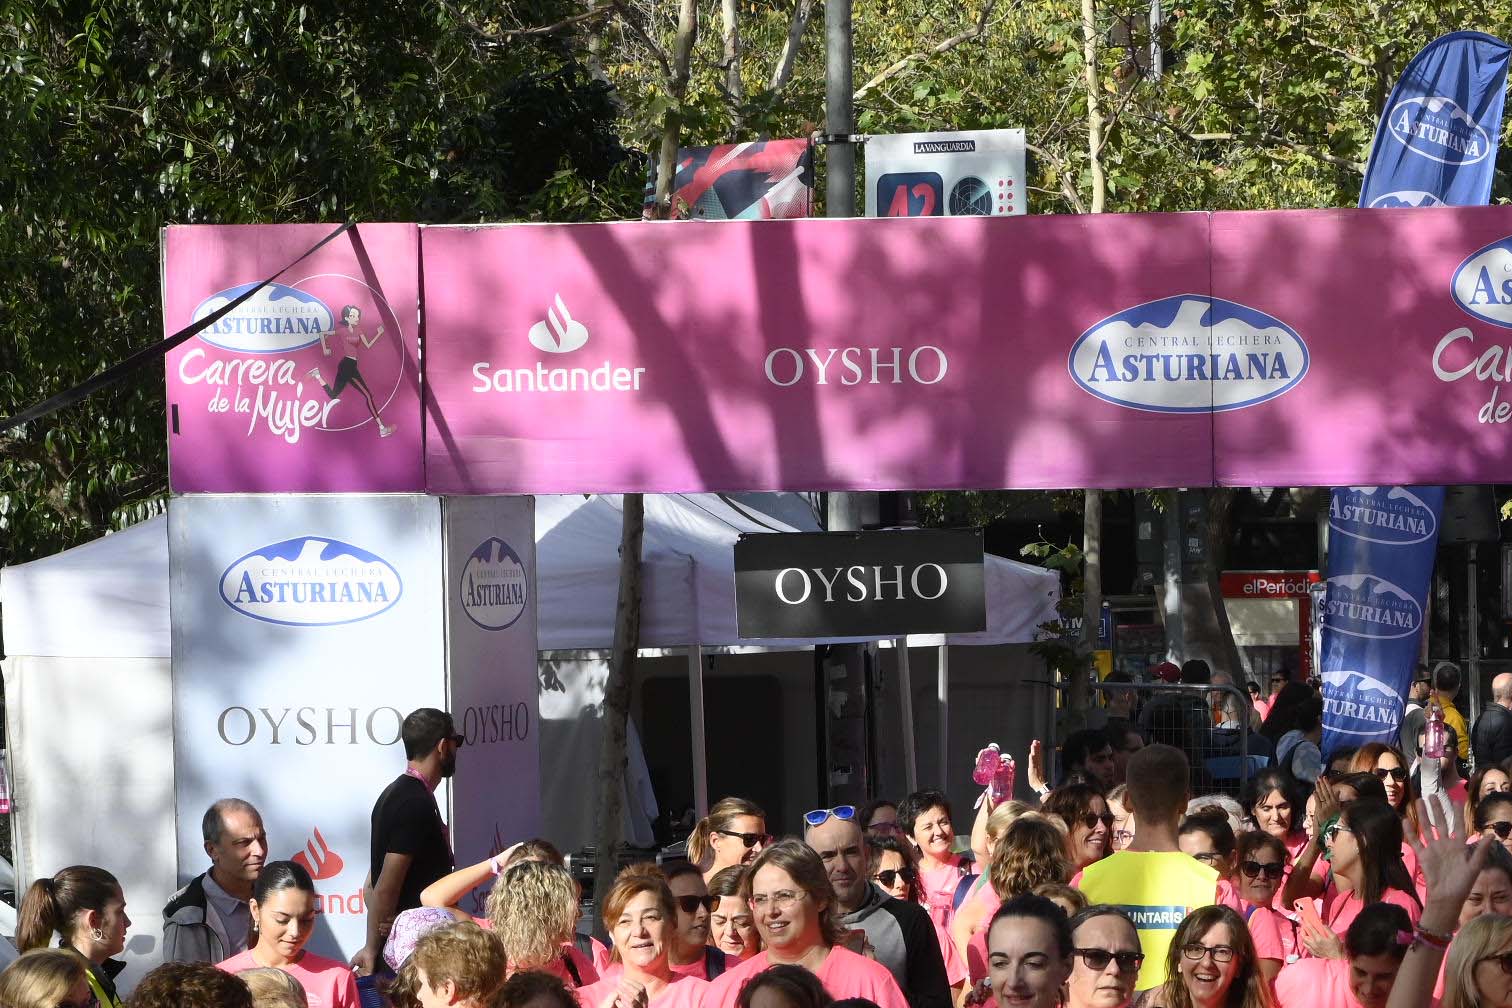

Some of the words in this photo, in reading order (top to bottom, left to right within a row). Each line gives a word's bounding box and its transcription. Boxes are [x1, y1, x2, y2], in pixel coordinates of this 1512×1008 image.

[1395, 109, 1480, 157] ASTURIANA
[179, 348, 295, 385] Carrera
[472, 361, 646, 392] Santander
[765, 346, 948, 386] OYSHO
[1088, 339, 1291, 383] ASTURIANA
[208, 387, 229, 413] de
[235, 386, 250, 413] la
[248, 382, 340, 444] Mujer
[1478, 386, 1512, 425] de
[1330, 494, 1428, 535] ASTURIANA
[234, 570, 389, 603] ASTURIANA
[466, 571, 524, 607] ASTURIANA
[774, 562, 948, 604] OYSHO
[1324, 600, 1414, 629] STURIANA
[217, 706, 402, 746] OYSHO
[462, 701, 529, 745] OYSHO
[1322, 698, 1397, 725] TURIANA
[1130, 911, 1183, 925] UNTARIS
